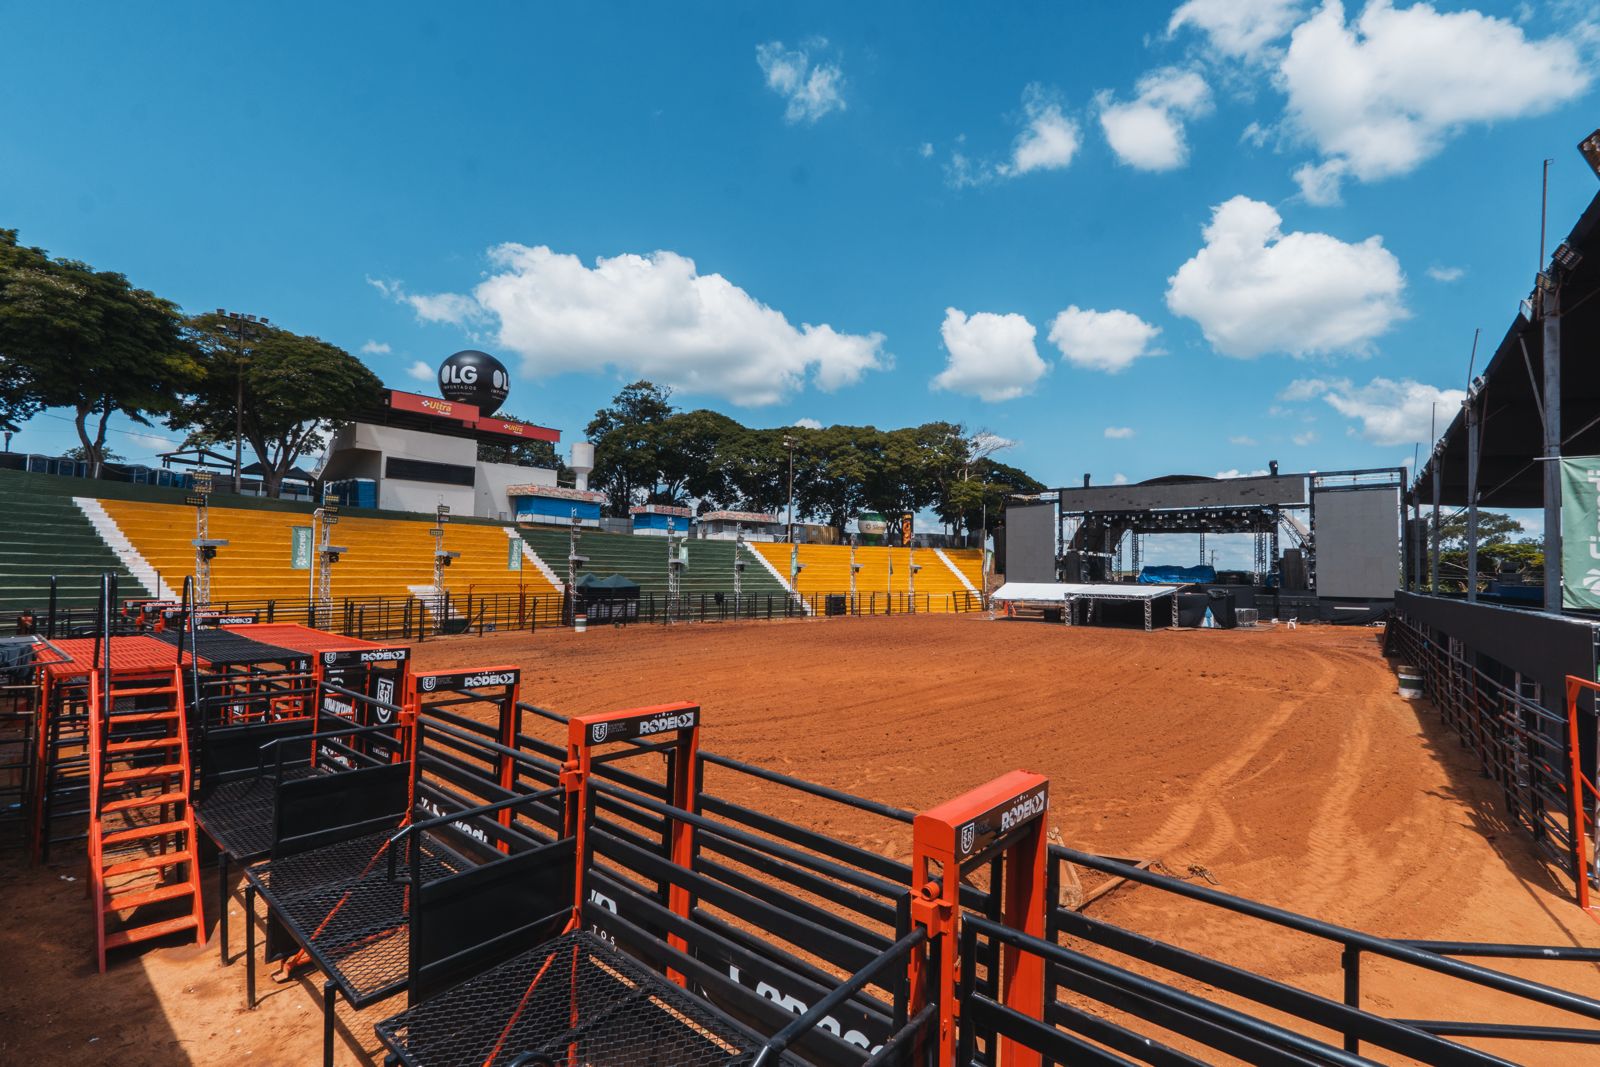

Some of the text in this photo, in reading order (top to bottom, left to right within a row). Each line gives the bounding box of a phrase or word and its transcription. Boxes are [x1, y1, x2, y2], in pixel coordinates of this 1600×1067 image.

[429, 400, 452, 413] Ultra
[464, 673, 514, 687] RODEIO
[640, 712, 694, 735] RODEIO
[1001, 793, 1044, 832] RODEIO
